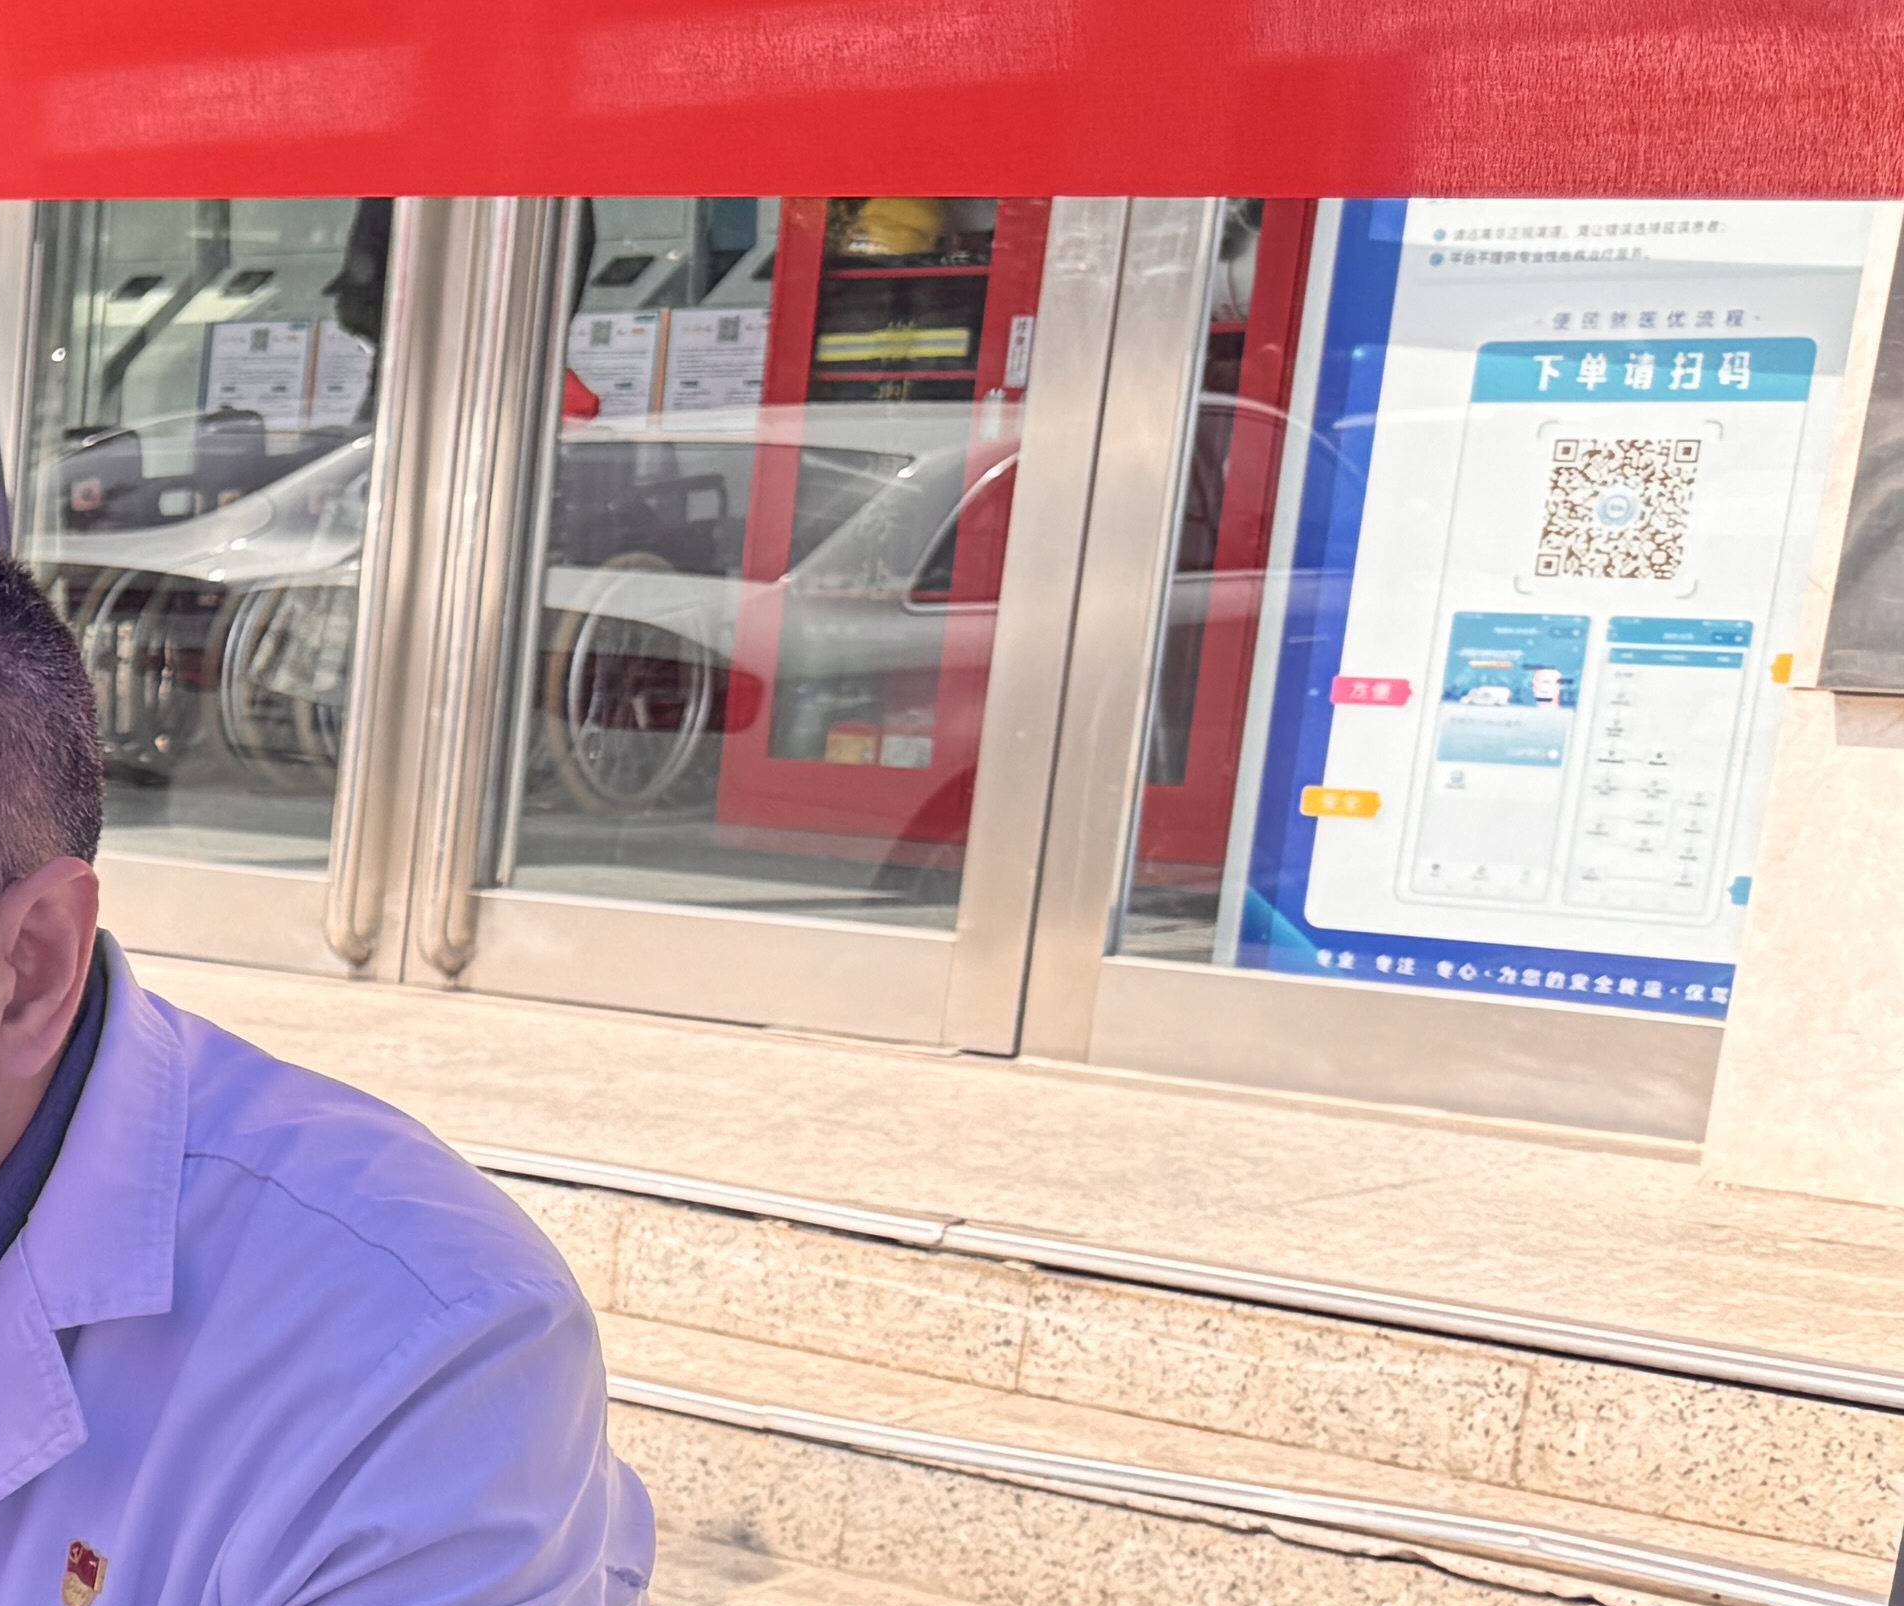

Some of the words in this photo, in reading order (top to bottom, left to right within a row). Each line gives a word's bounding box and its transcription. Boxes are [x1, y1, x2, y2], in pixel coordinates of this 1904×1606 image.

[1533, 350, 1753, 392] 下单请扫码
